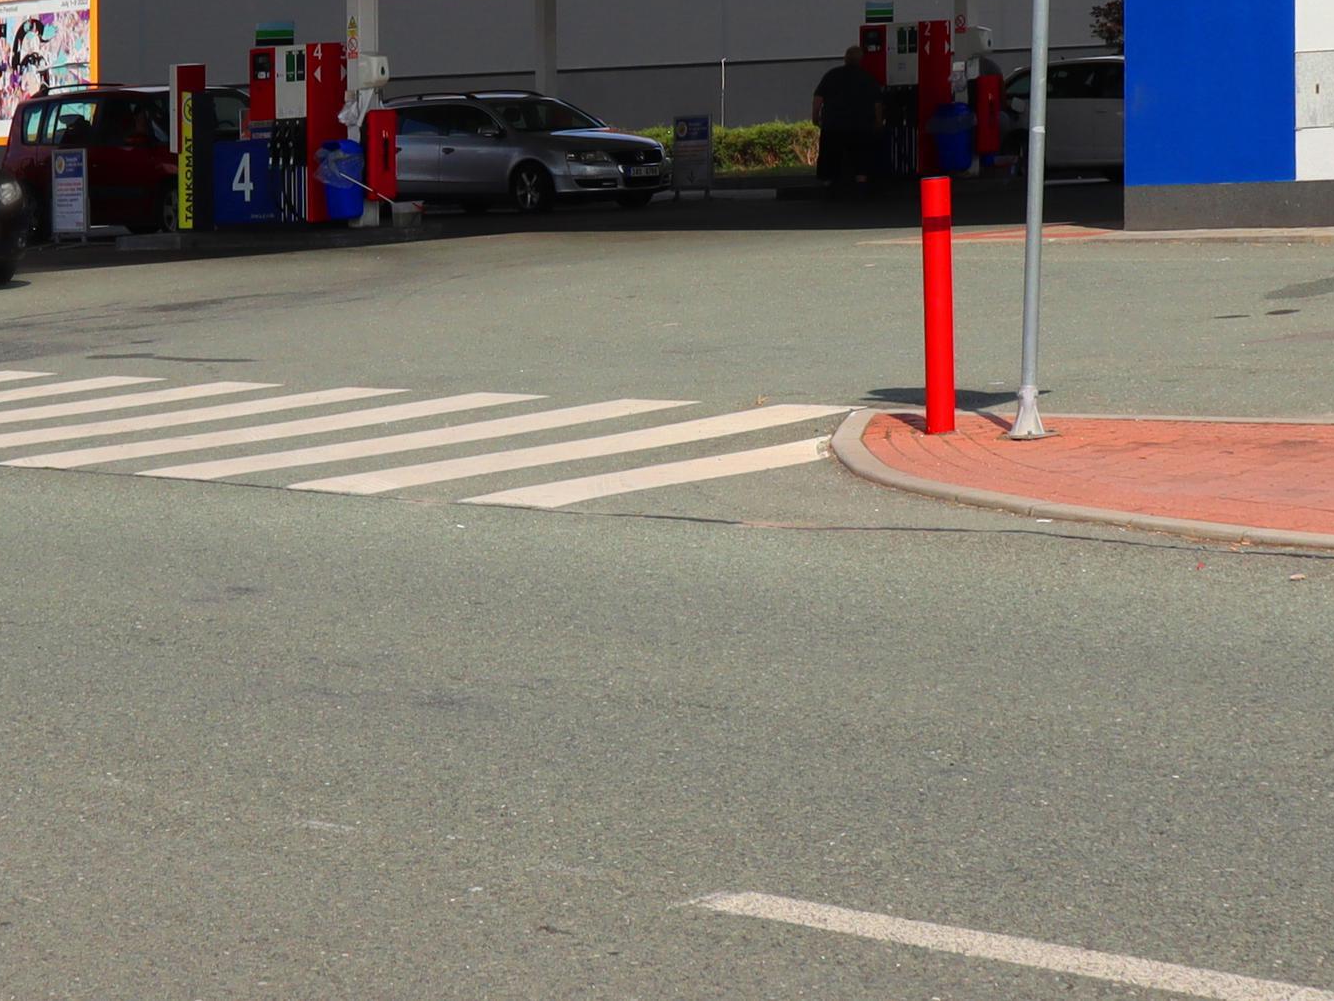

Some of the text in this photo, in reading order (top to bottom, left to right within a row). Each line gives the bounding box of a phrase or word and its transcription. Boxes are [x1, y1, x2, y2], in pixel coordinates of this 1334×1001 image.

[924, 21, 932, 36] 2
[944, 21, 950, 35] 1
[313, 43, 322, 60] 4
[185, 136, 193, 223] TANKOMAT
[232, 152, 254, 202] 4
